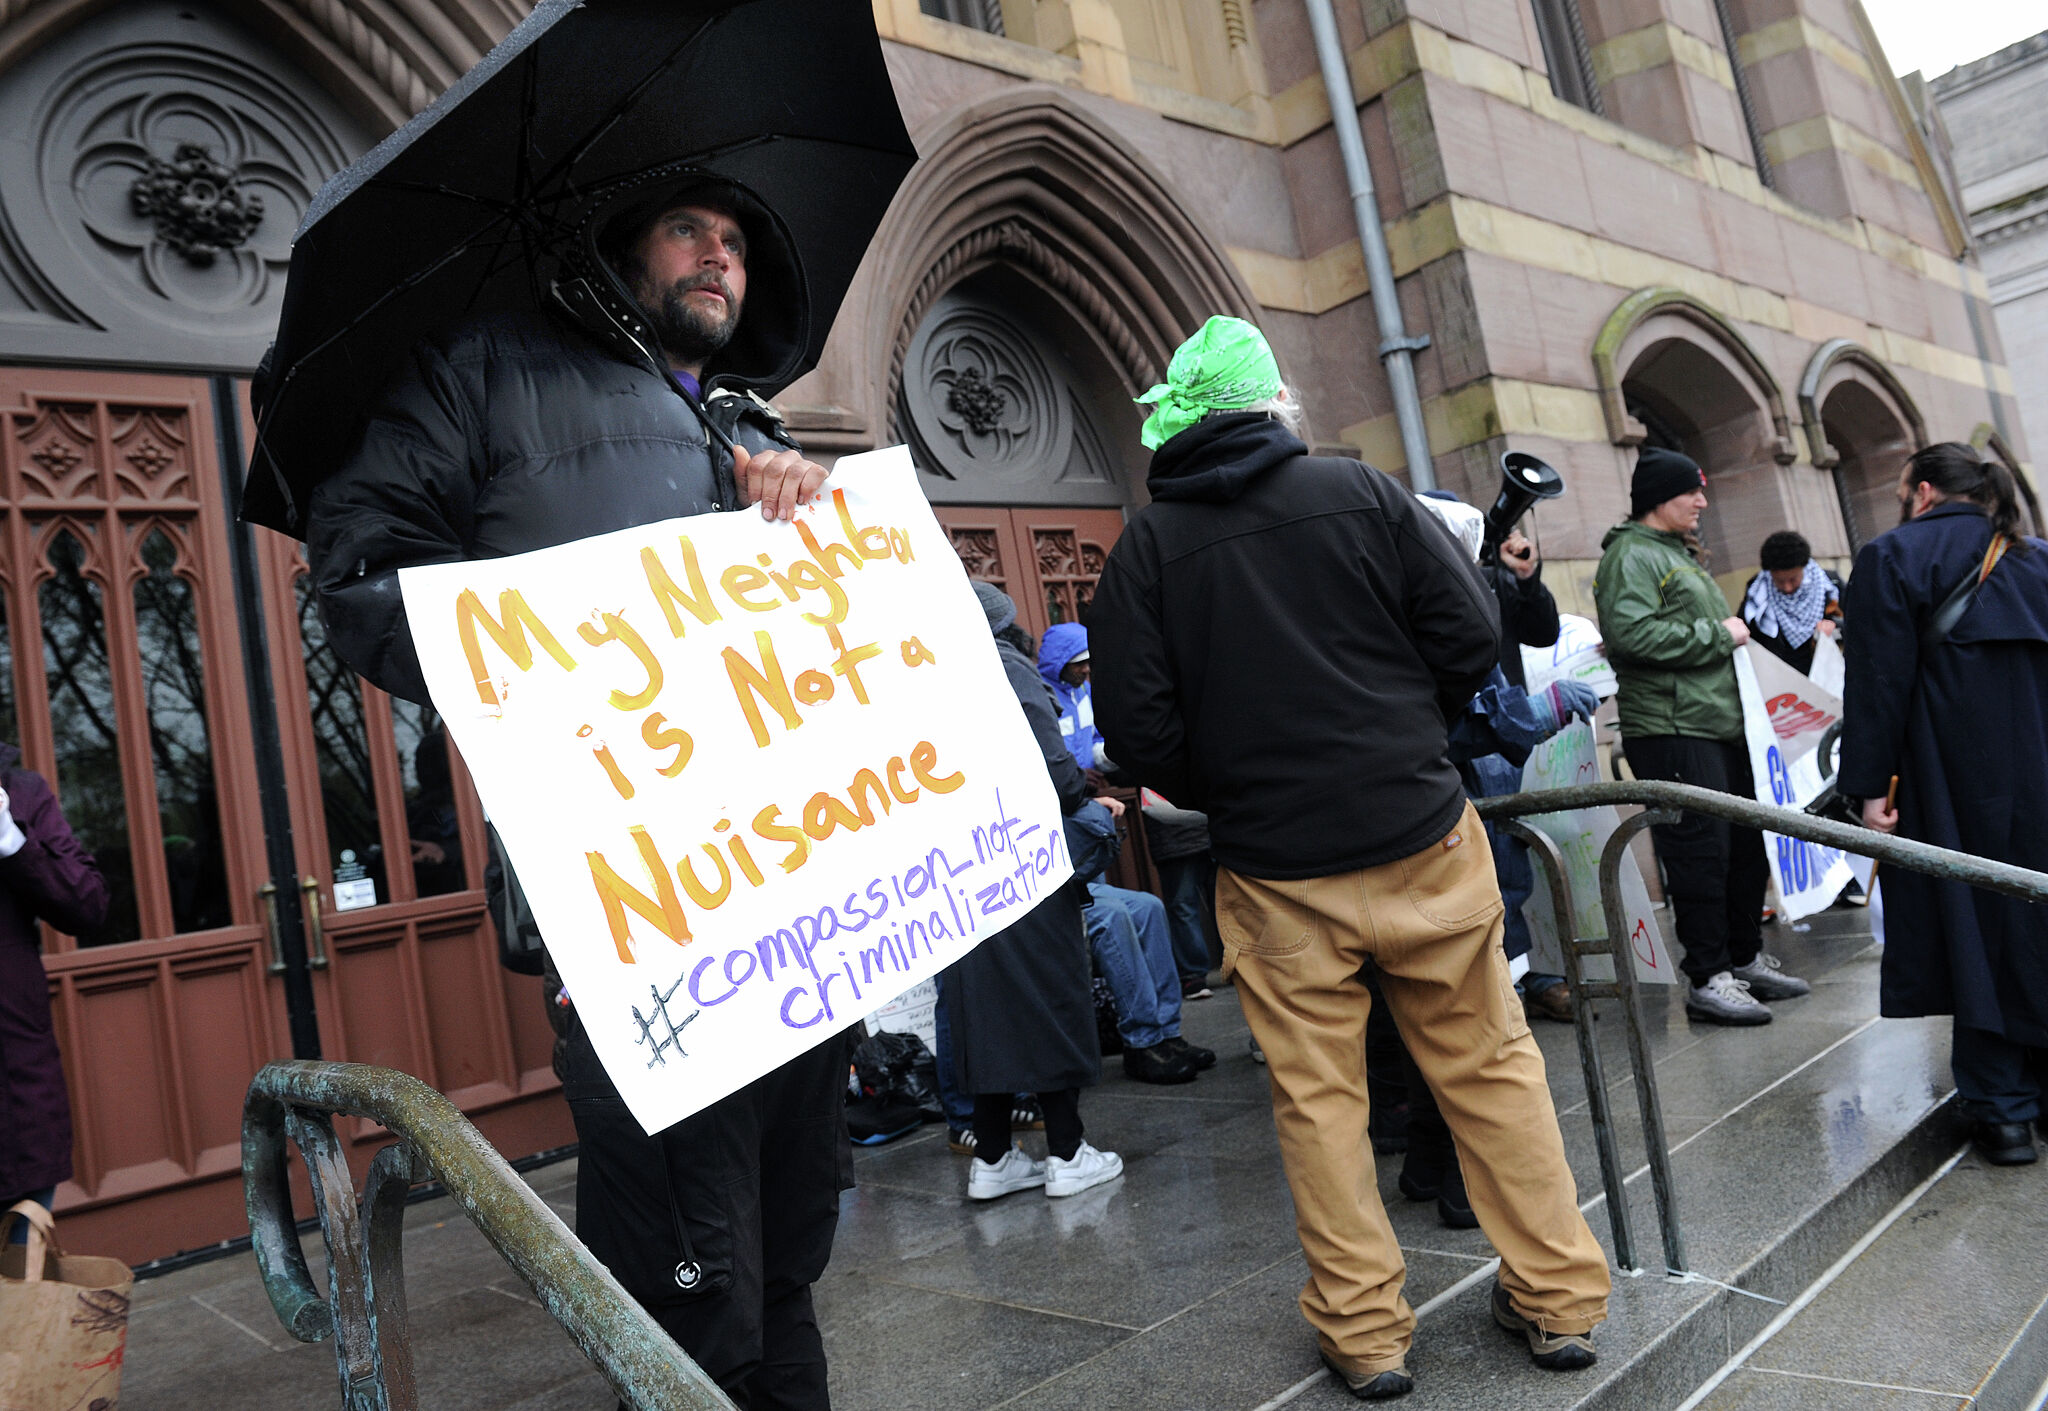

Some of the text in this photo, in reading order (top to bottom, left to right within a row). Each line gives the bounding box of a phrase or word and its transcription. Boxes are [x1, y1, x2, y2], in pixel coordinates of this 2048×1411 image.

[456, 586, 665, 716] My
[575, 621, 936, 801] is Not a
[585, 740, 966, 965] Nuisance
[779, 829, 1068, 1030] criminalization
